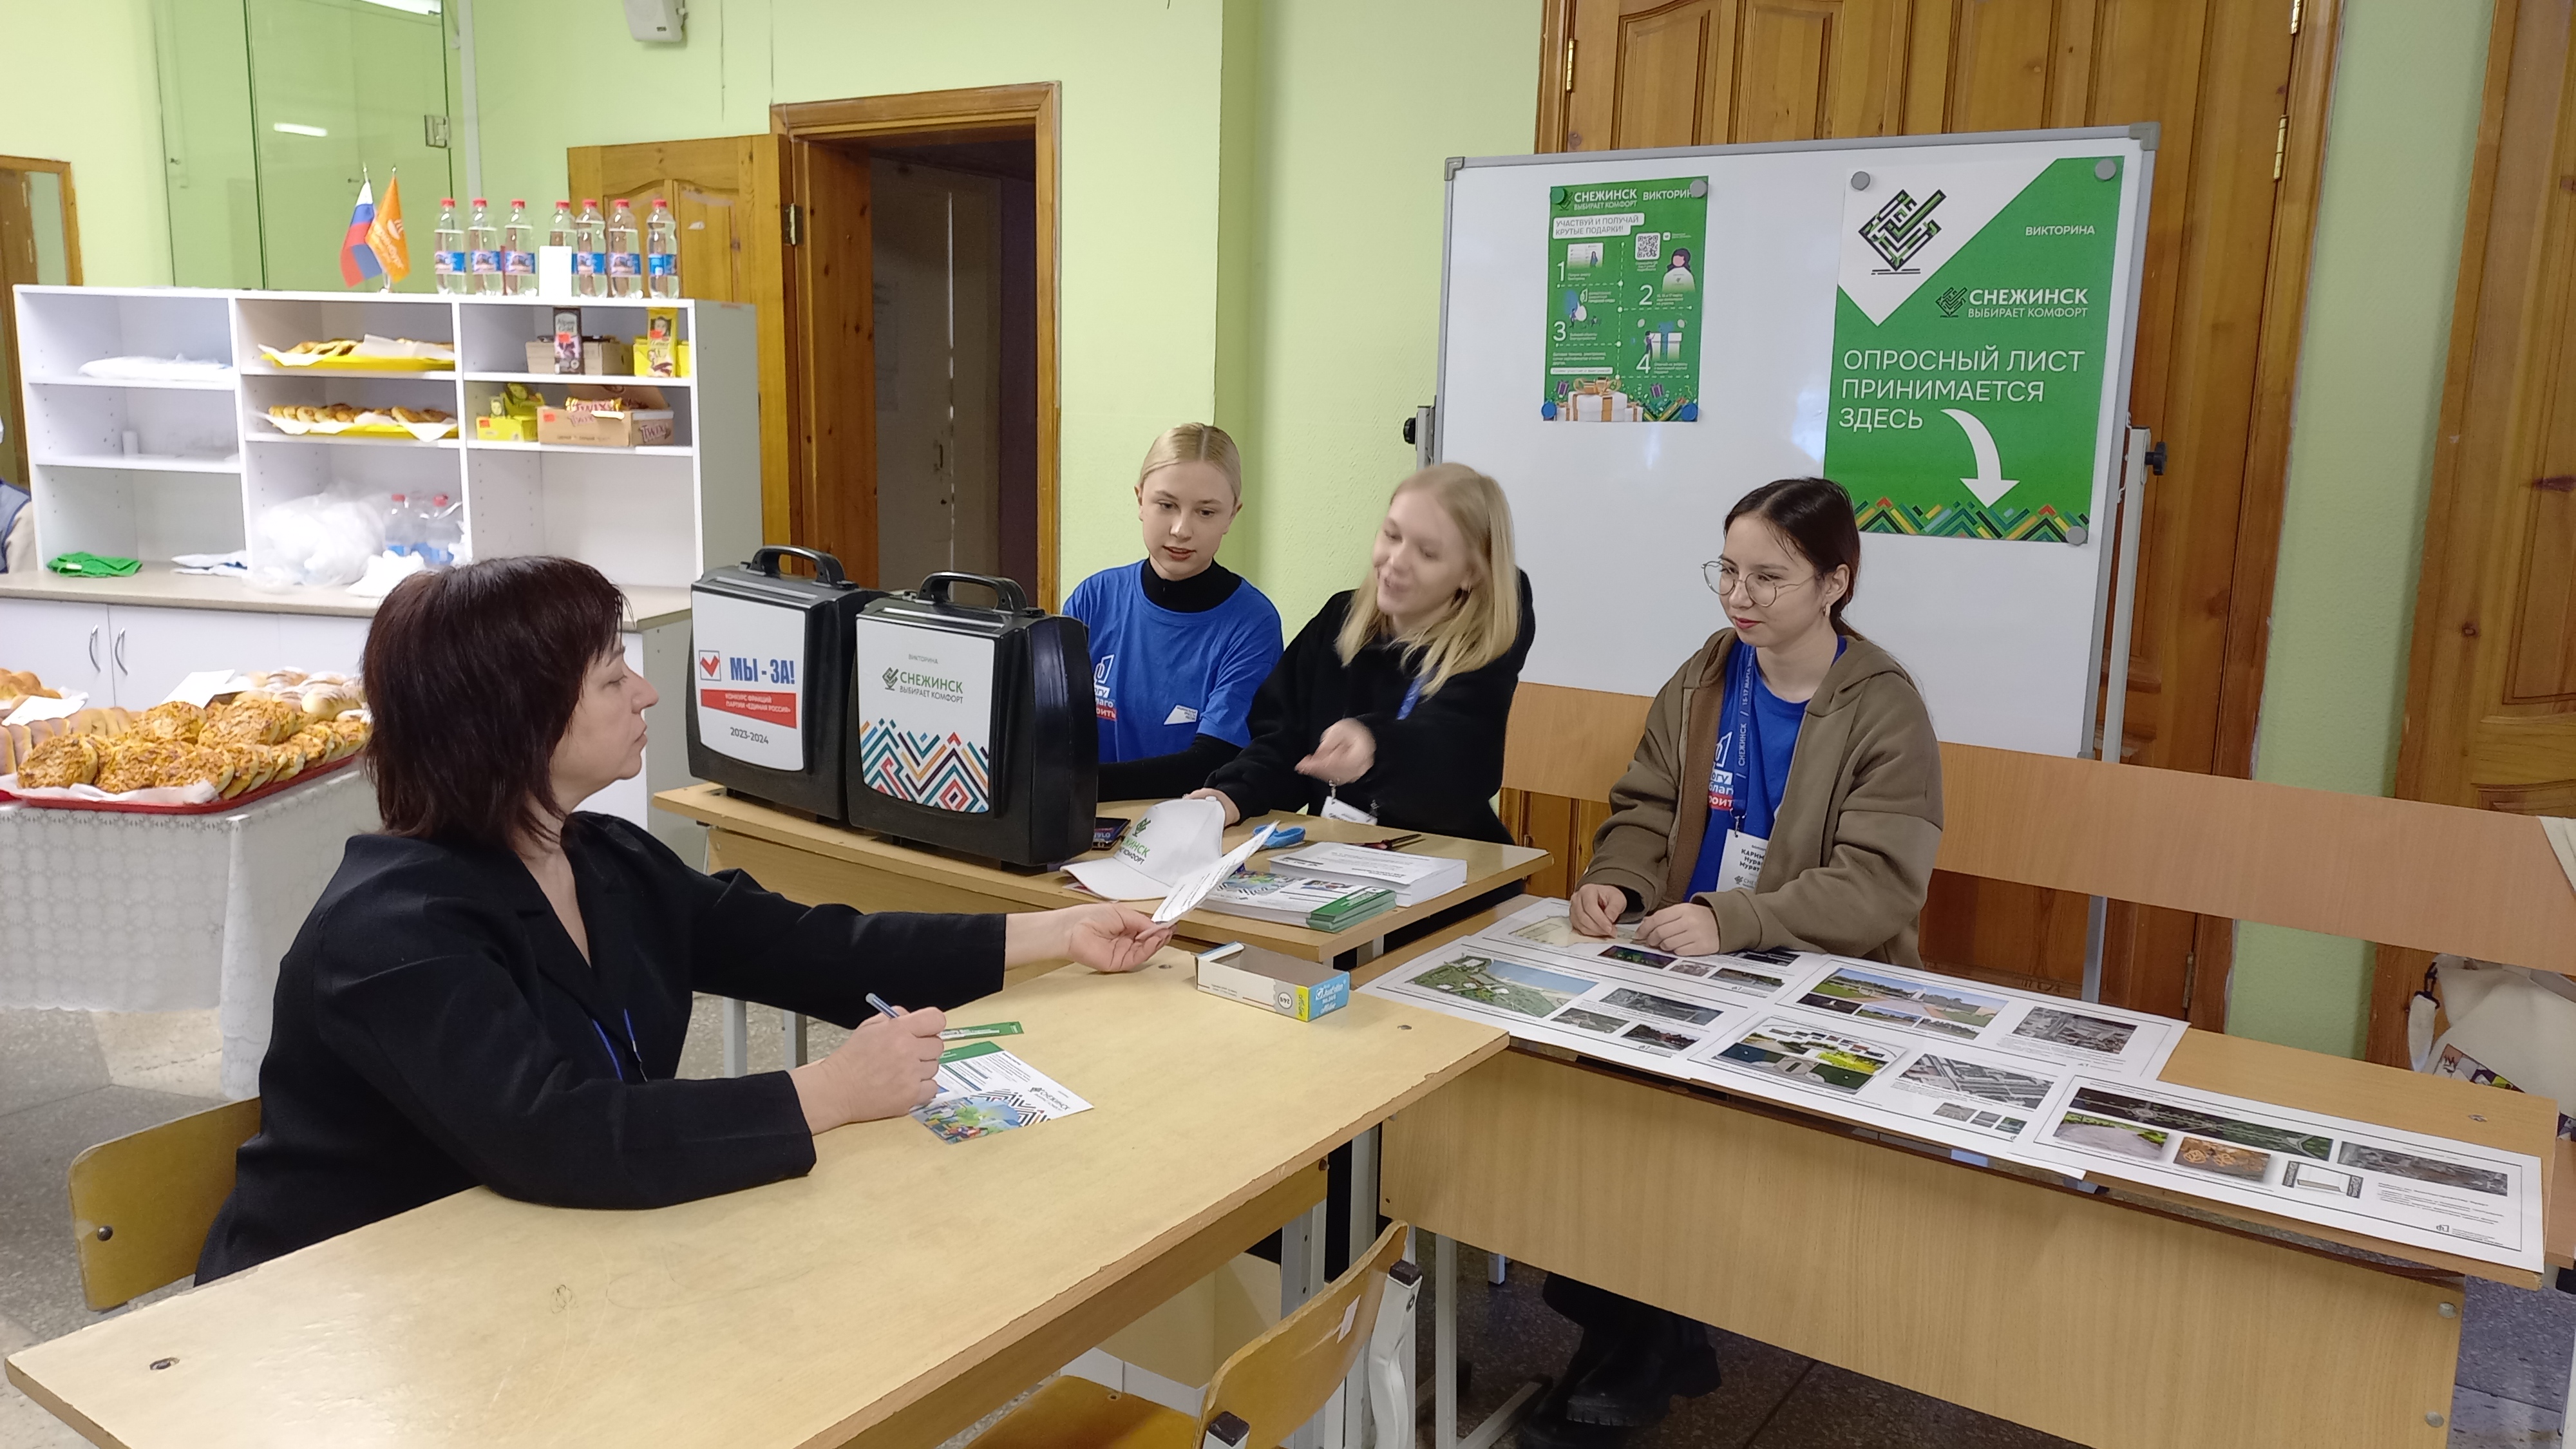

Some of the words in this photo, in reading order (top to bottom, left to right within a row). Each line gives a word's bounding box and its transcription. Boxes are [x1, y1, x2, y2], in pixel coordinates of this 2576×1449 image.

[1574, 188, 1637, 202] СНЕЖИНСК
[1643, 189, 1694, 201] ВИКТОРИН
[1573, 202, 1604, 211] ВЫБИРАЕТ
[1605, 200, 1637, 209] КОМФОРТ
[1556, 216, 1594, 227] УЧАСТВУЙ
[1602, 214, 1639, 225] ПОЛУЧАЙ
[1555, 227, 1584, 236] КРУТЫЕ
[1586, 226, 1624, 235] ПОДАРКИ!
[2025, 225, 2096, 236] ВИКТОРИНА
[1557, 261, 1565, 282] 1
[1638, 285, 1654, 306] 2
[1969, 287, 2088, 306] СНЕЖИНСК
[1968, 308, 2024, 318] ВЫБИРАЕТ
[2027, 307, 2088, 318] КОМФОРТ
[1553, 321, 1566, 342] 3
[1636, 354, 1651, 374] 4
[1844, 345, 1999, 372] ОПРОСНЫЙ
[2006, 350, 2085, 372] ЛИСТ
[1842, 379, 2045, 402] ПРИНИМАЕТСЯ
[1839, 408, 1924, 433] ЗДЕСЬ
[908, 653, 938, 665] ВИКТОРИНА
[730, 656, 759, 683] МЫ
[770, 659, 796, 685] ЗА!
[899, 670, 963, 694] СНЕЖИНСК
[899, 686, 930, 699] ВЫБИРАЕТ
[931, 690, 964, 705] КОМФОРТ
[730, 726, 770, 745] 2023-2024
[1738, 723, 1747, 766] СНЕЖИНСК
[1745, 856, 1763, 866] Нура
